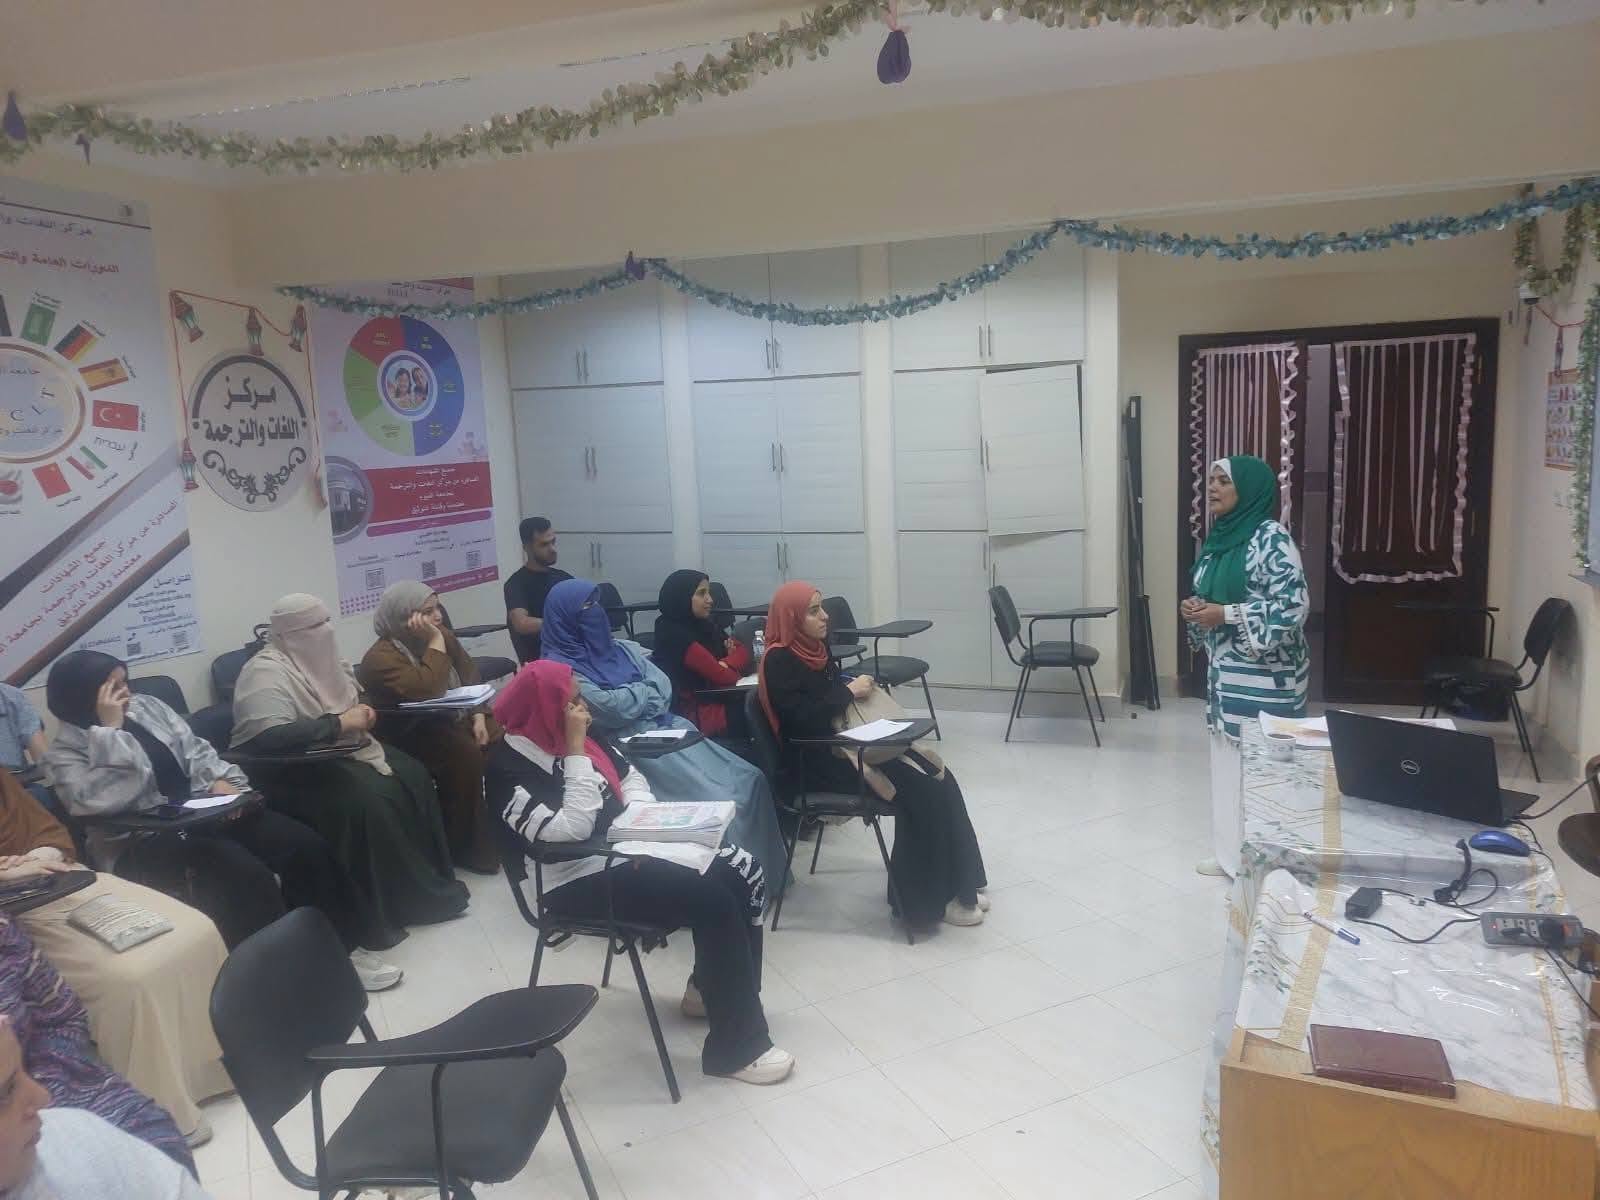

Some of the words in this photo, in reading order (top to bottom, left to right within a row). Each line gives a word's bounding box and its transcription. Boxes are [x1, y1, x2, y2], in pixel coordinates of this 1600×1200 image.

[223, 375, 277, 412] مركز
[202, 416, 266, 448] والترجمة
[267, 415, 300, 441] اللغات
[149, 498, 178, 526] الصادرة
[139, 526, 151, 538] عن
[39, 558, 81, 594] الشهادات
[84, 554, 114, 580] اللغات
